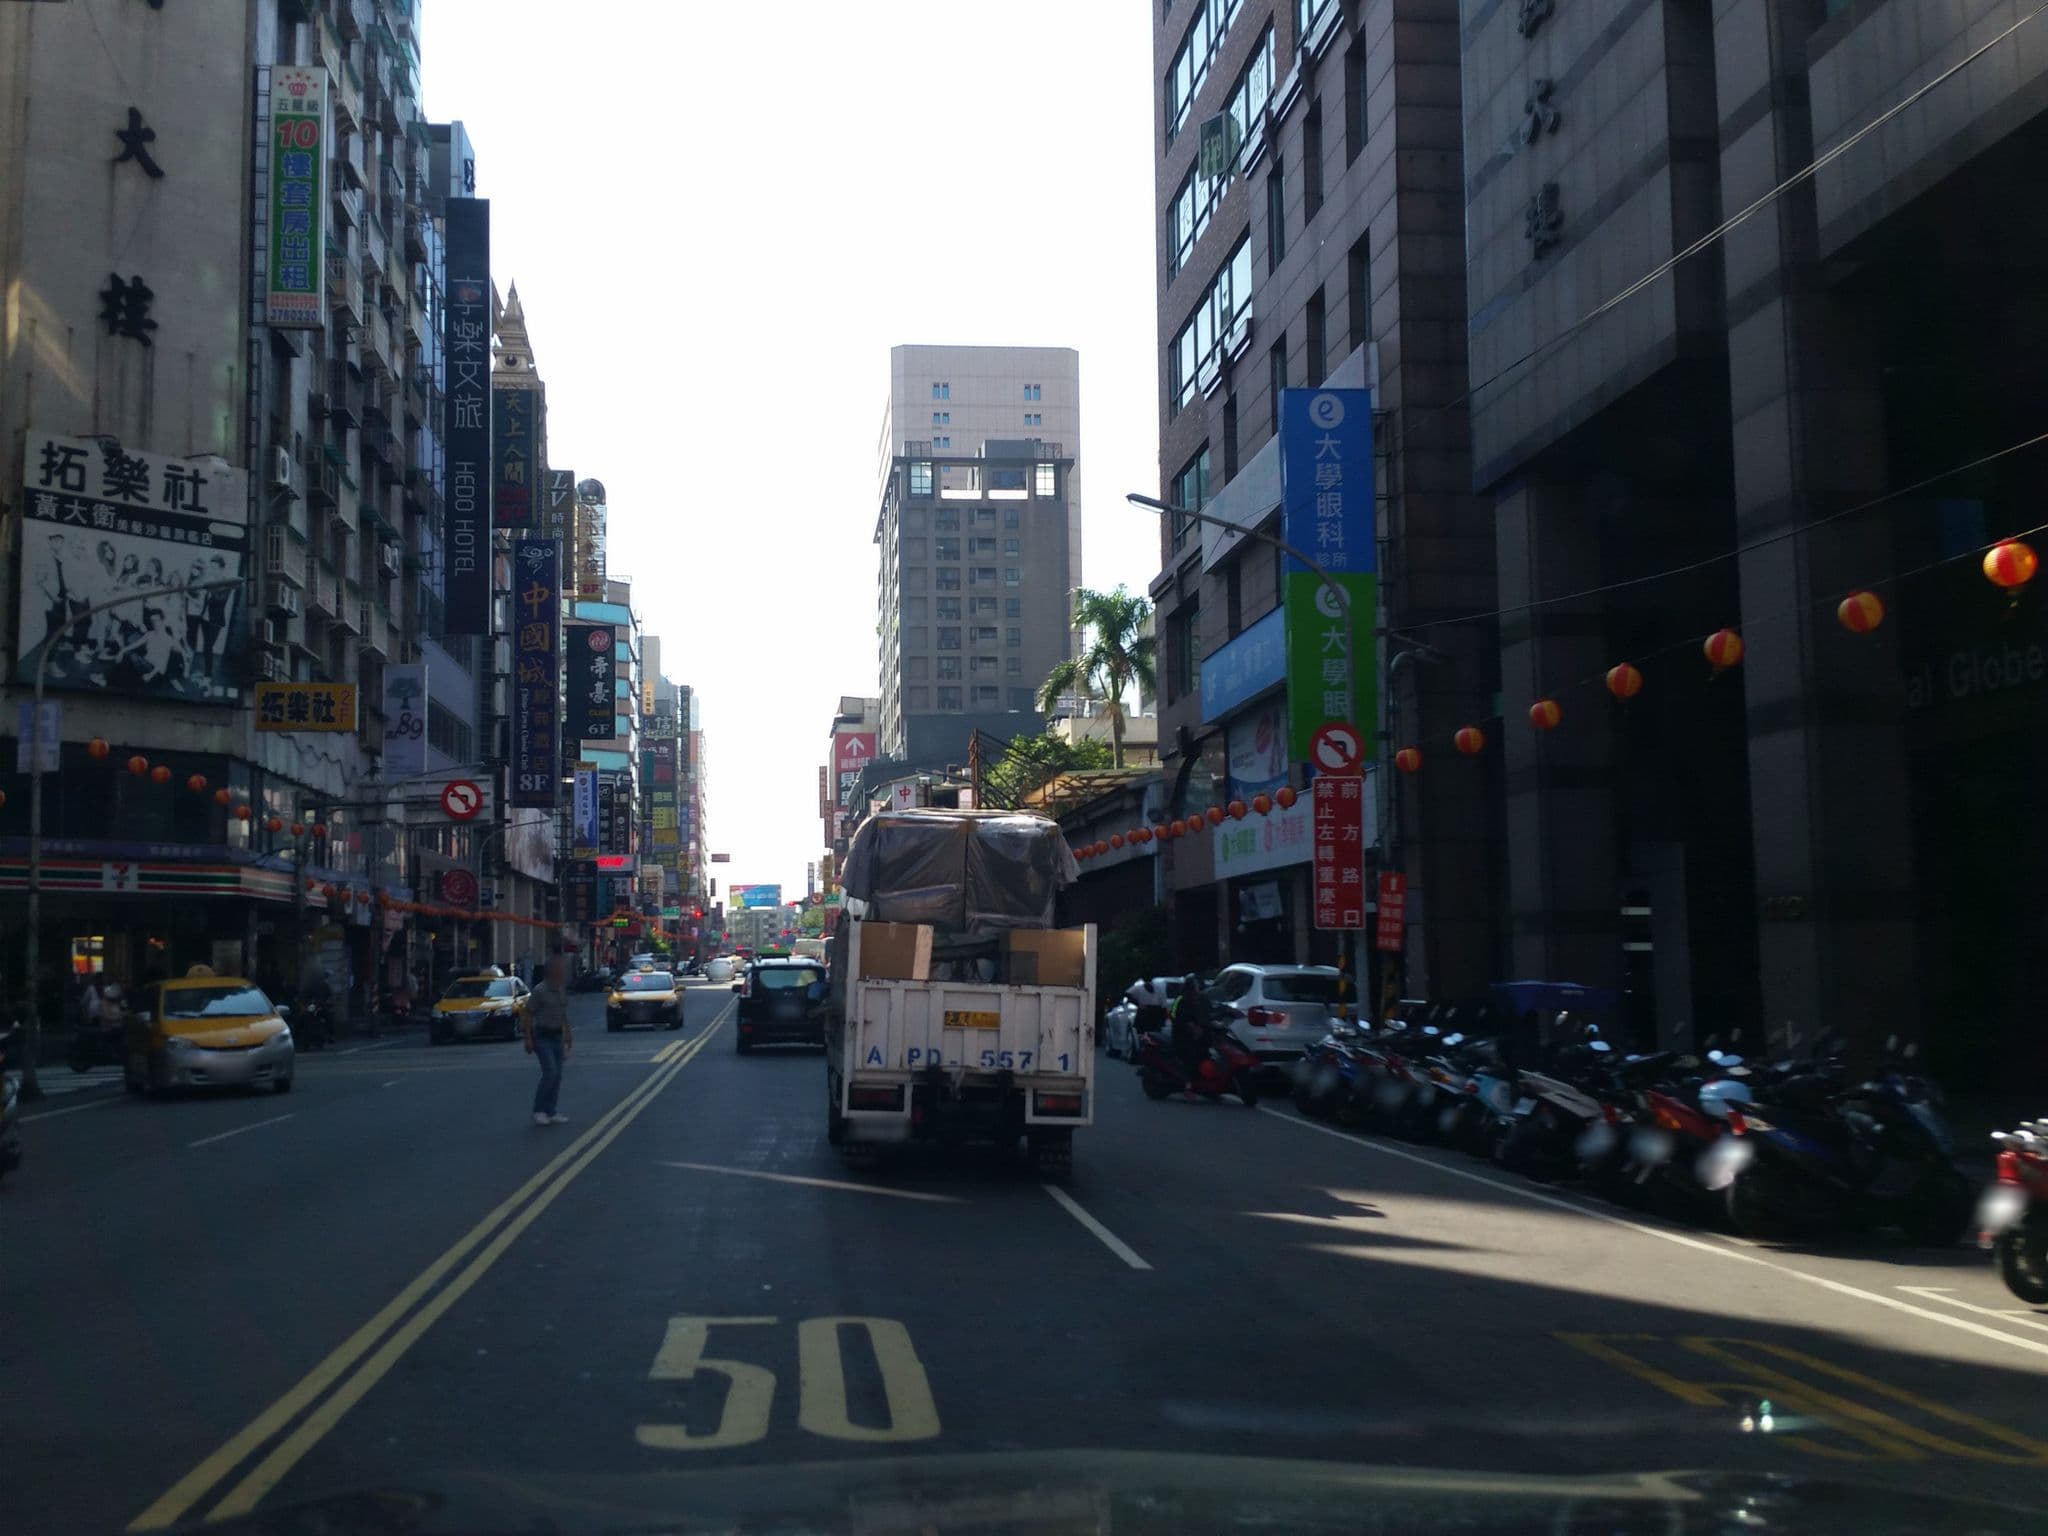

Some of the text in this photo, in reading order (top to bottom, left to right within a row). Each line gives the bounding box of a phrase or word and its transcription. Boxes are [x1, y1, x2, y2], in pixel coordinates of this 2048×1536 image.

[34, 492, 117, 530] 黃大衛
[1315, 432, 1345, 549] 大學眼科
[455, 518, 477, 577] HOTEL
[518, 581, 553, 688] 中國城
[588, 724, 610, 735] 6F
[519, 774, 549, 791] 8F
[1341, 783, 1361, 925] 前方路口
[634, 1315, 942, 1451] 50
